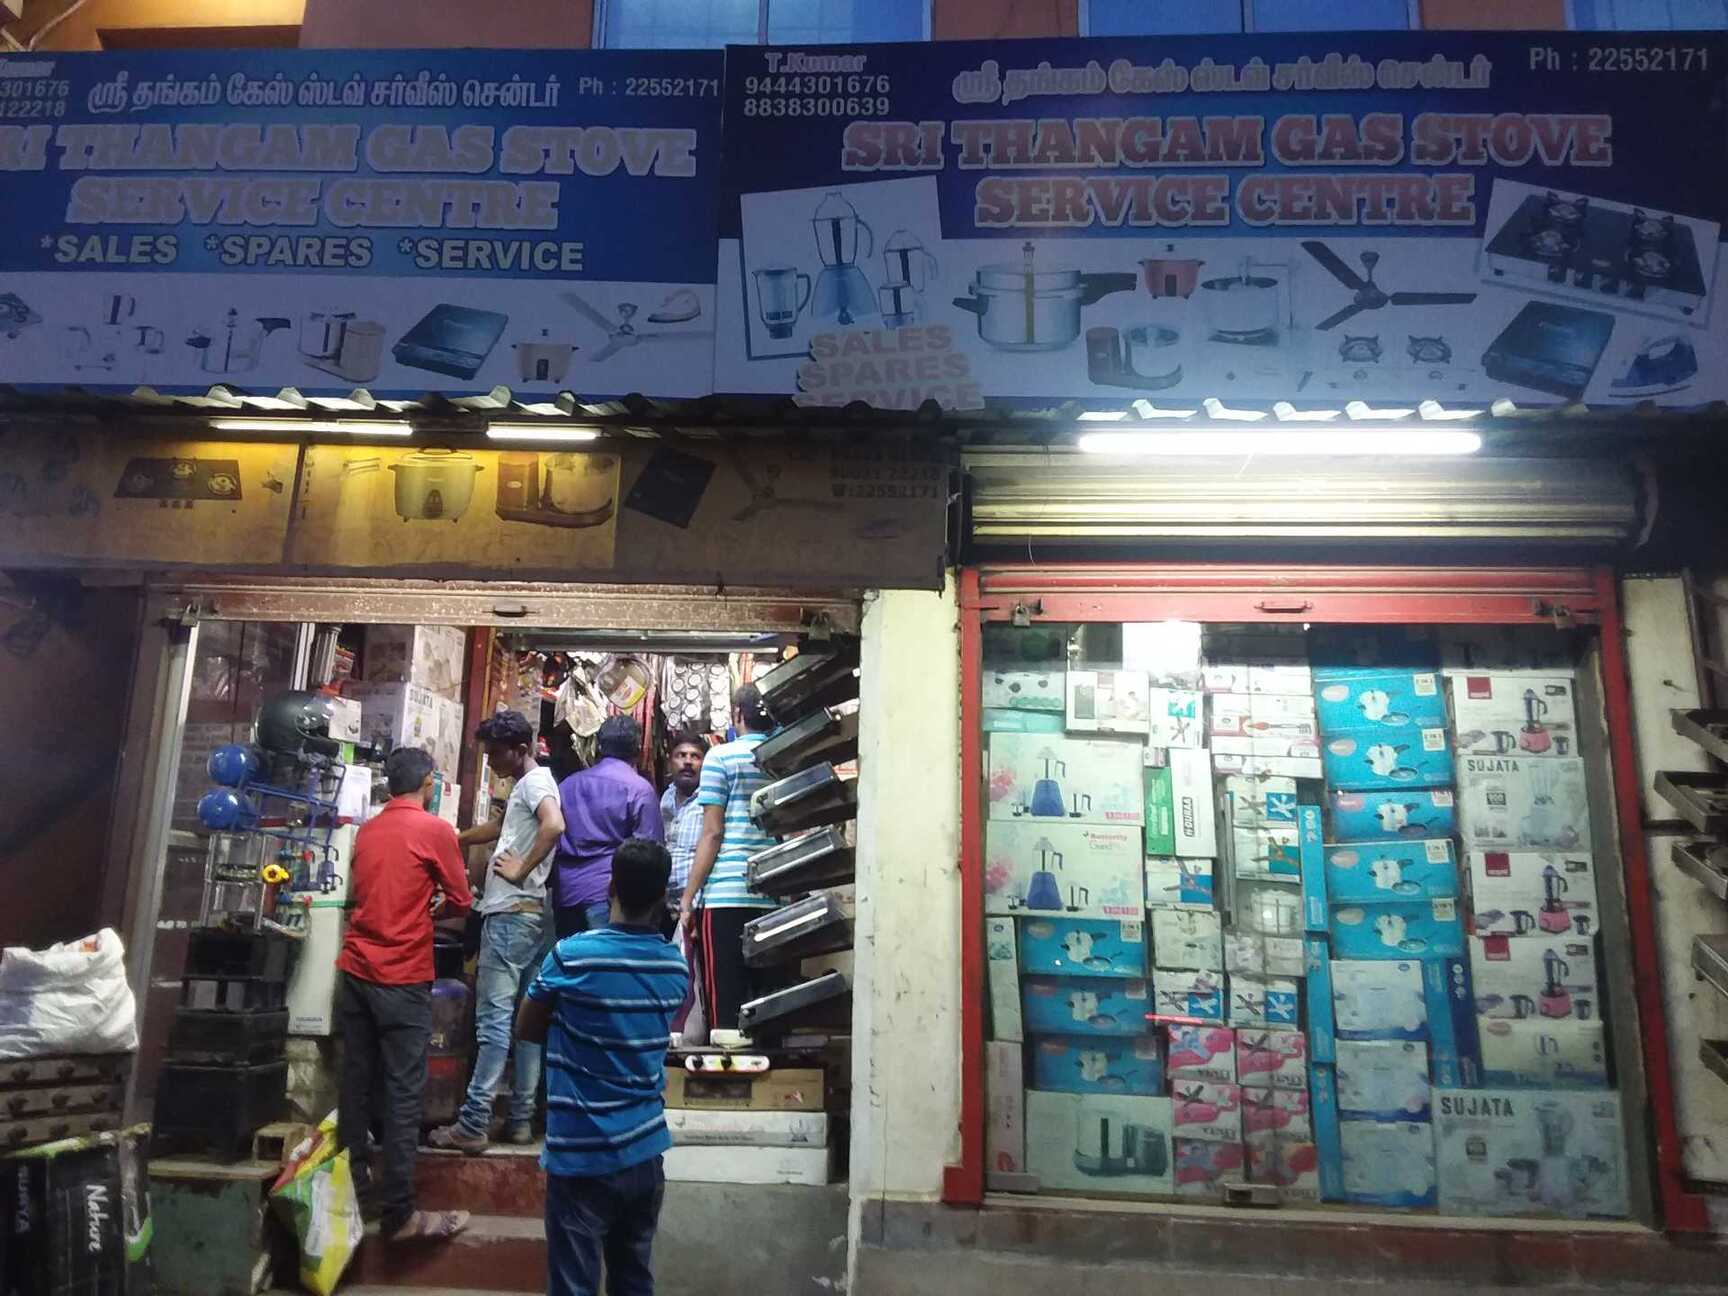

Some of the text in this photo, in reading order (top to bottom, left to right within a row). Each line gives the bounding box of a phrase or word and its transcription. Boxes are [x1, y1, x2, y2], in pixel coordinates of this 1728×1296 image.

[764, 53, 867, 73] T.Kumar
[1529, 47, 1561, 71] Ph
[1588, 47, 1709, 73] 22552171
[578, 75, 603, 96] Ph
[625, 77, 720, 97] 22552171
[744, 76, 890, 96] 9444301676
[743, 97, 890, 117] 8838300639
[56, 122, 361, 172] THANGAM
[365, 123, 495, 174] GAS
[499, 125, 697, 177] STOVE
[841, 112, 1613, 171] SRI THANGAM GAS STOVE
[64, 175, 561, 231] SERVICE CENTRE
[974, 173, 1476, 229] SERVICE CENTRE
[812, 325, 952, 357] SALES
[799, 352, 973, 389] SPARES
[1467, 759, 1520, 772] SUJATA
[1441, 1096, 1514, 1117] SUJATA
[86, 1184, 109, 1252] Nature
